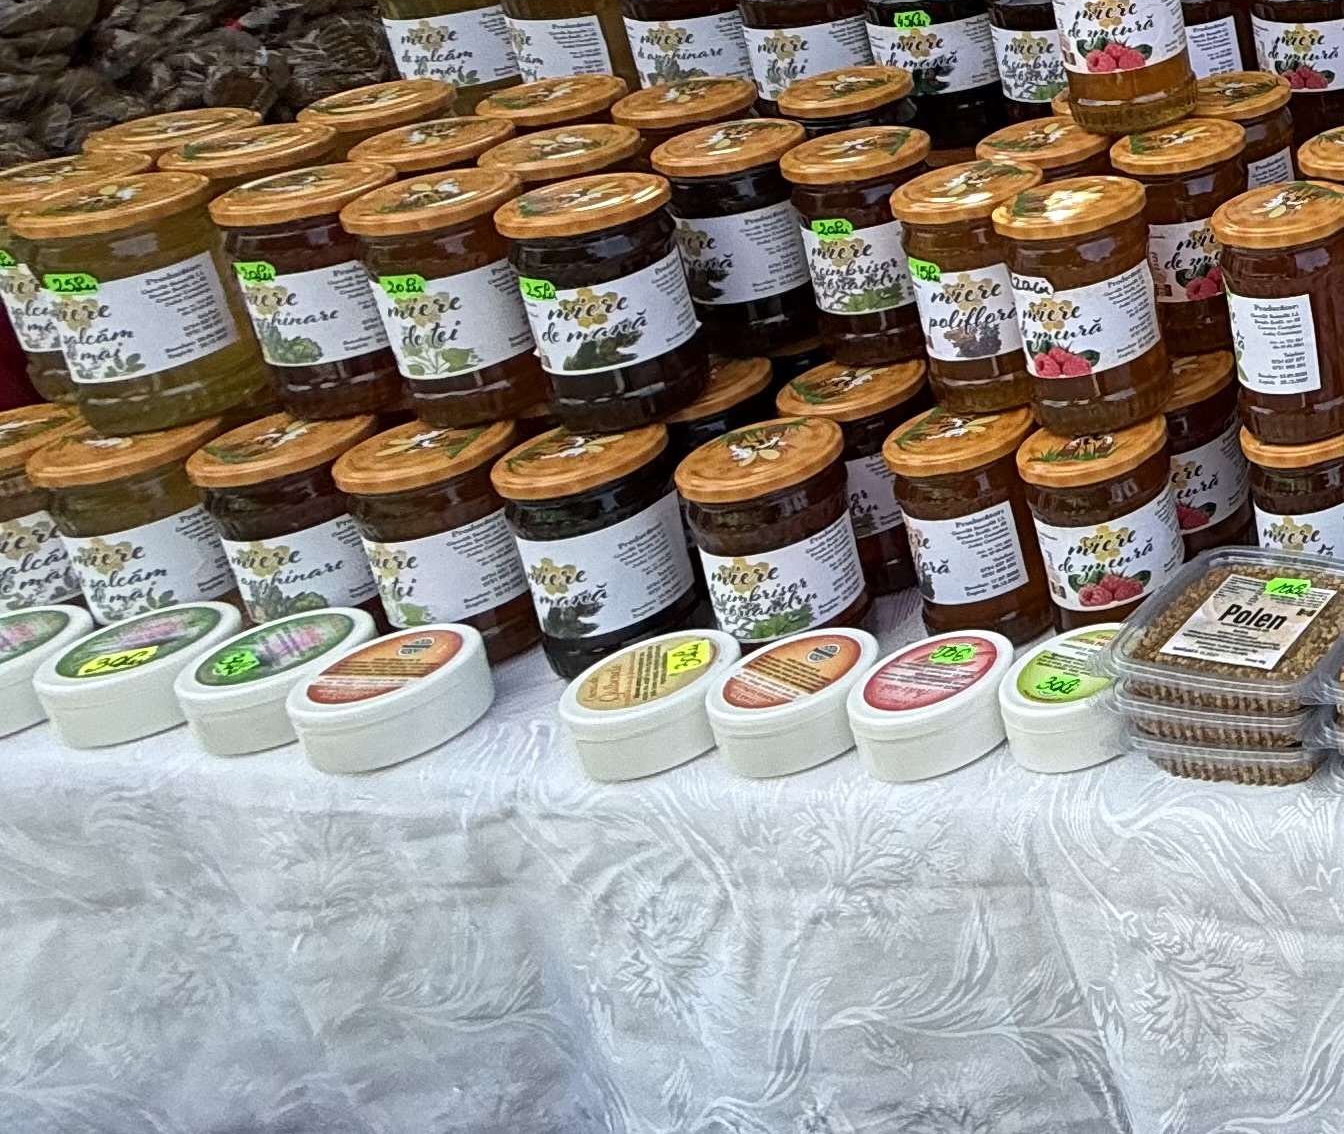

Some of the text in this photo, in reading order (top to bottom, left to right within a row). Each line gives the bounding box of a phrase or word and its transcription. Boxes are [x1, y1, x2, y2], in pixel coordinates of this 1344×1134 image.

[1075, 2, 1140, 22] miere
[931, 281, 1002, 304] miere
[548, 297, 628, 321] miere
[1067, 528, 1137, 558] miere
[1219, 604, 1288, 631] Polen
